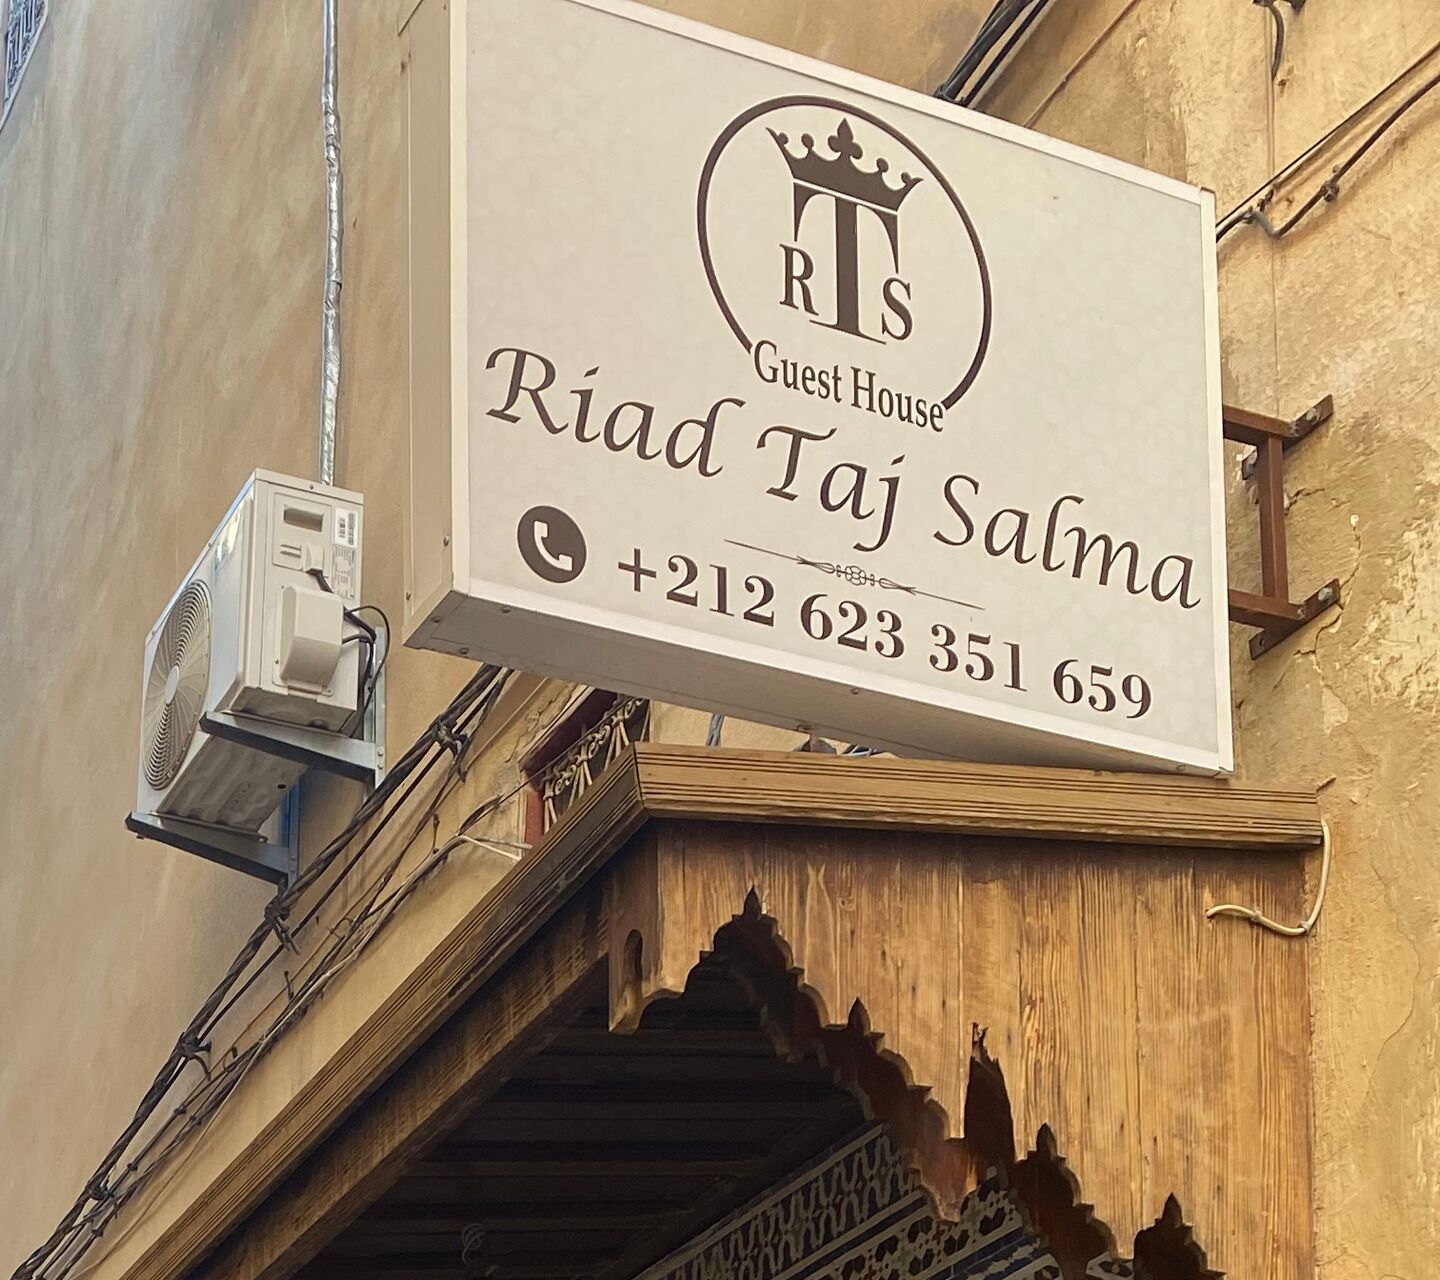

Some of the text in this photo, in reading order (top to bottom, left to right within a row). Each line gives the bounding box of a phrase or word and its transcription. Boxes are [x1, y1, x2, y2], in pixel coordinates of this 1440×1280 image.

[754, 340, 945, 434] Guest House
[485, 346, 1202, 610] Riad Taj Salma
[617, 547, 1153, 720] +212 623 351 659
